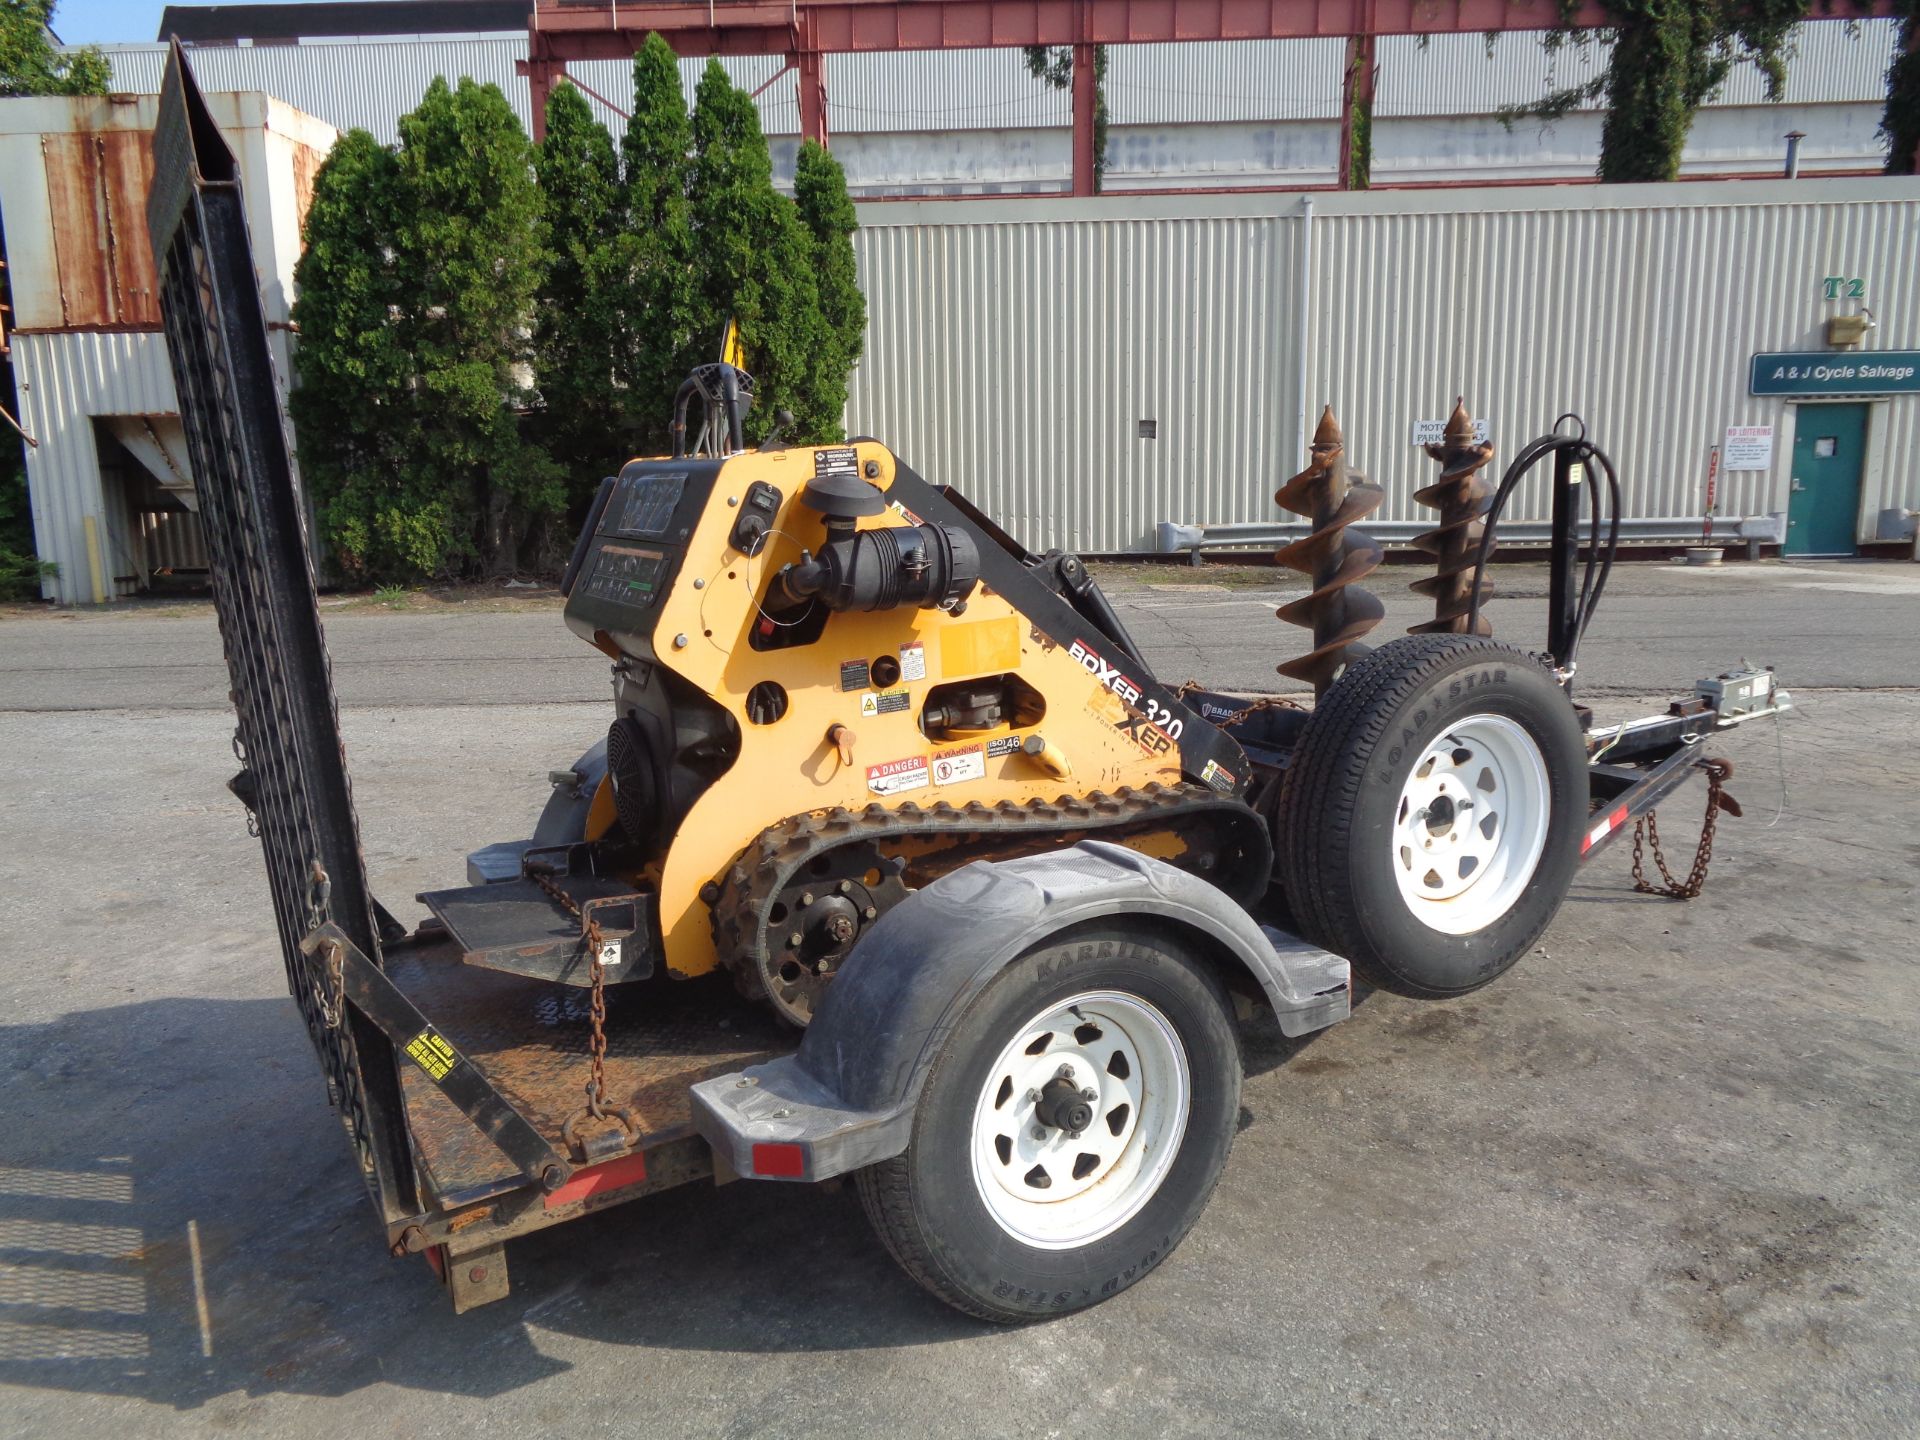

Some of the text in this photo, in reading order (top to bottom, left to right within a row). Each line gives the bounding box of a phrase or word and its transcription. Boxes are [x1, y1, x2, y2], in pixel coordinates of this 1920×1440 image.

[1772, 364, 1914, 381] A & J Cycle Salvage
[1740, 428, 1772, 436] LOITERING
[1068, 641, 1141, 706] BOXER
[1449, 670, 1507, 699] STAR
[1142, 699, 1183, 740] 320
[987, 737, 1020, 749] (ISO) 46
[882, 758, 922, 776] DANGER!
[431, 1034, 454, 1058] CAUTION
